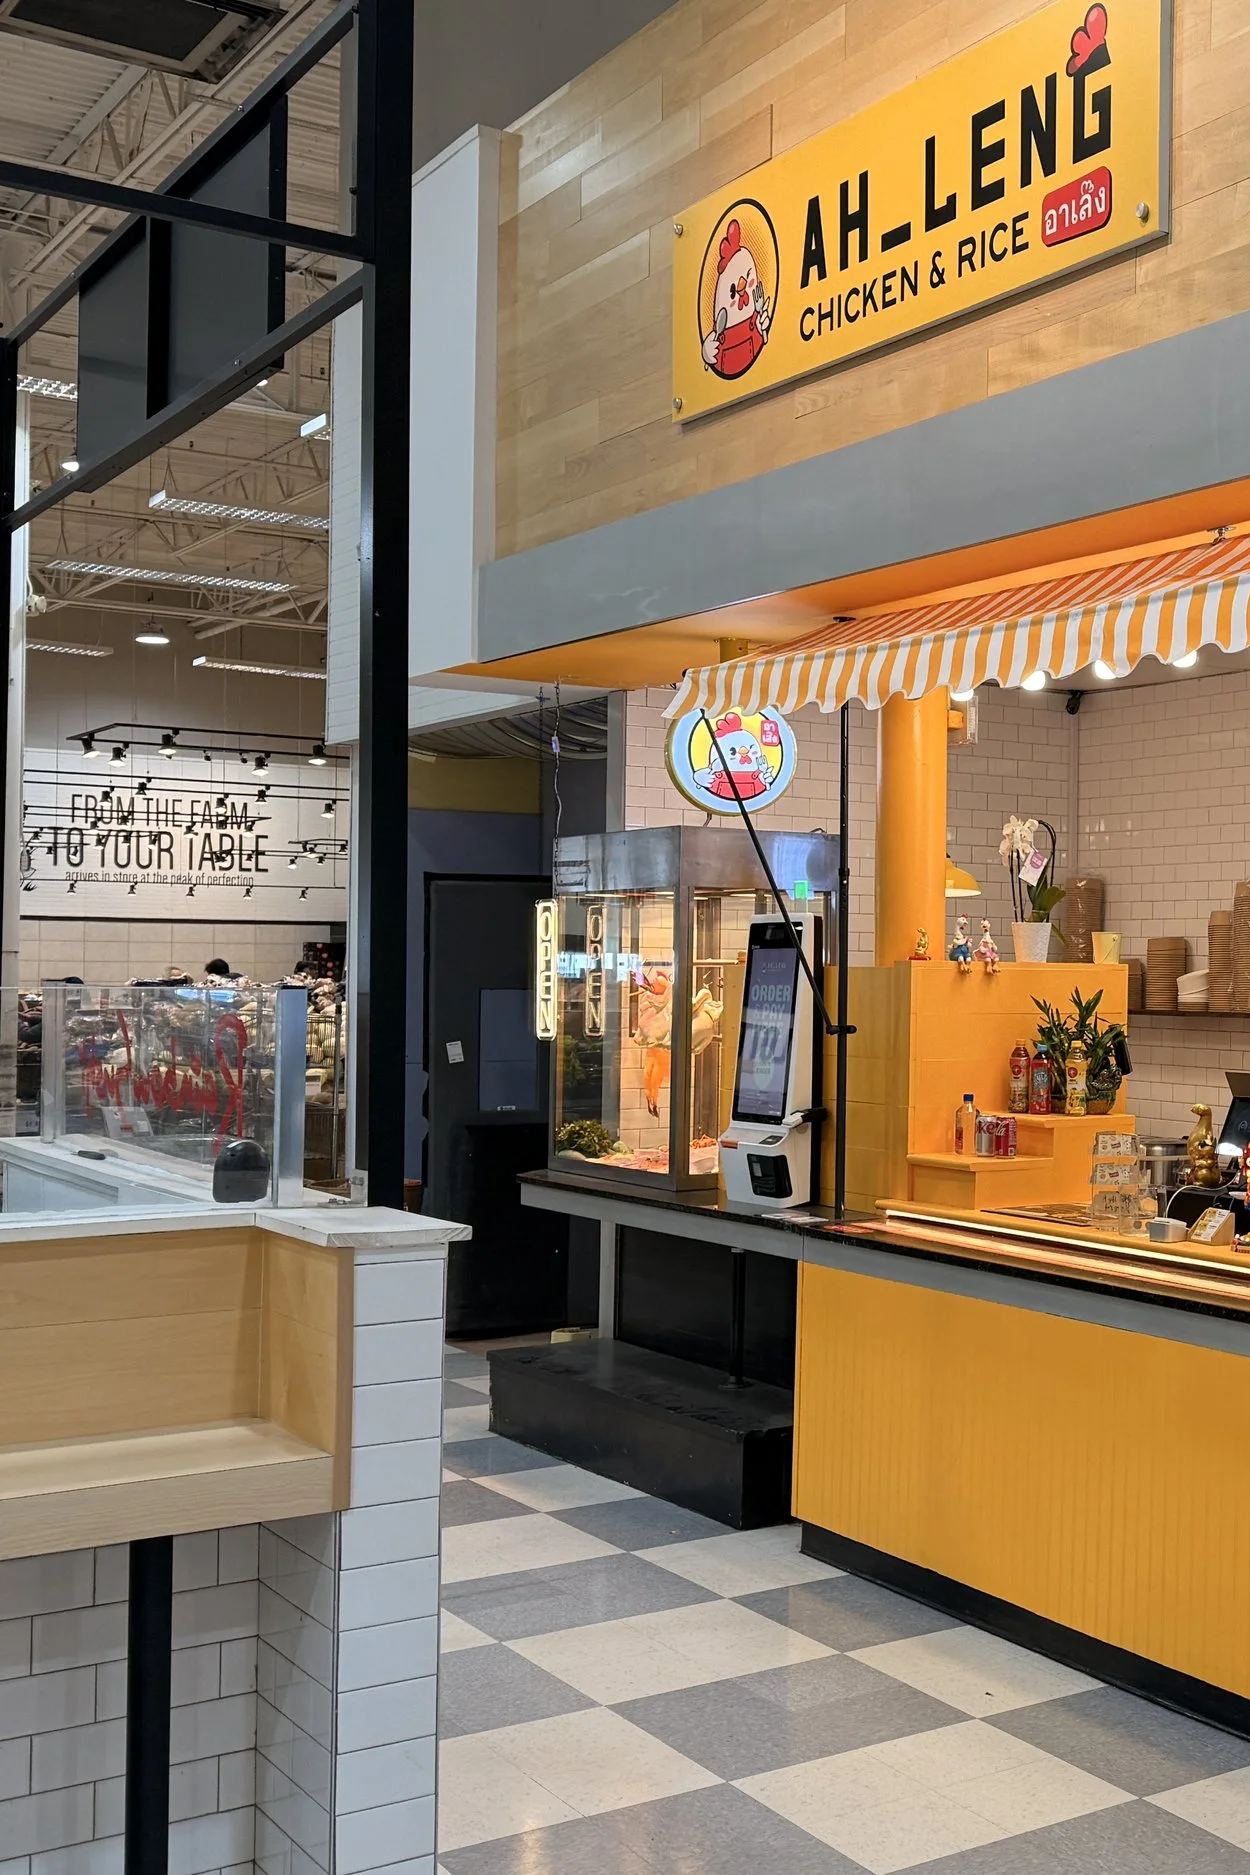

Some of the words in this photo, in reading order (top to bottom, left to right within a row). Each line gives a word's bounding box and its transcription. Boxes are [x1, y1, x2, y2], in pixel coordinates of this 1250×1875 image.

[799, 261, 919, 342] CHICKEN
[929, 251, 946, 288] &
[957, 211, 1030, 278] RICE
[143, 797, 183, 828] THE
[49, 826, 84, 868] TO
[98, 830, 174, 870] YOUR
[187, 832, 269, 873] TABLE
[65, 870, 99, 883] arrives
[102, 871, 110, 883] in
[113, 872, 137, 884] store
[140, 873, 150, 884] at
[153, 872, 168, 885] the
[195, 874, 205, 886] of
[207, 874, 254, 889] perfection
[539, 909, 553, 1034] OPEN
[751, 984, 791, 1003] ORDER
[762, 1003, 785, 1021] PAY
